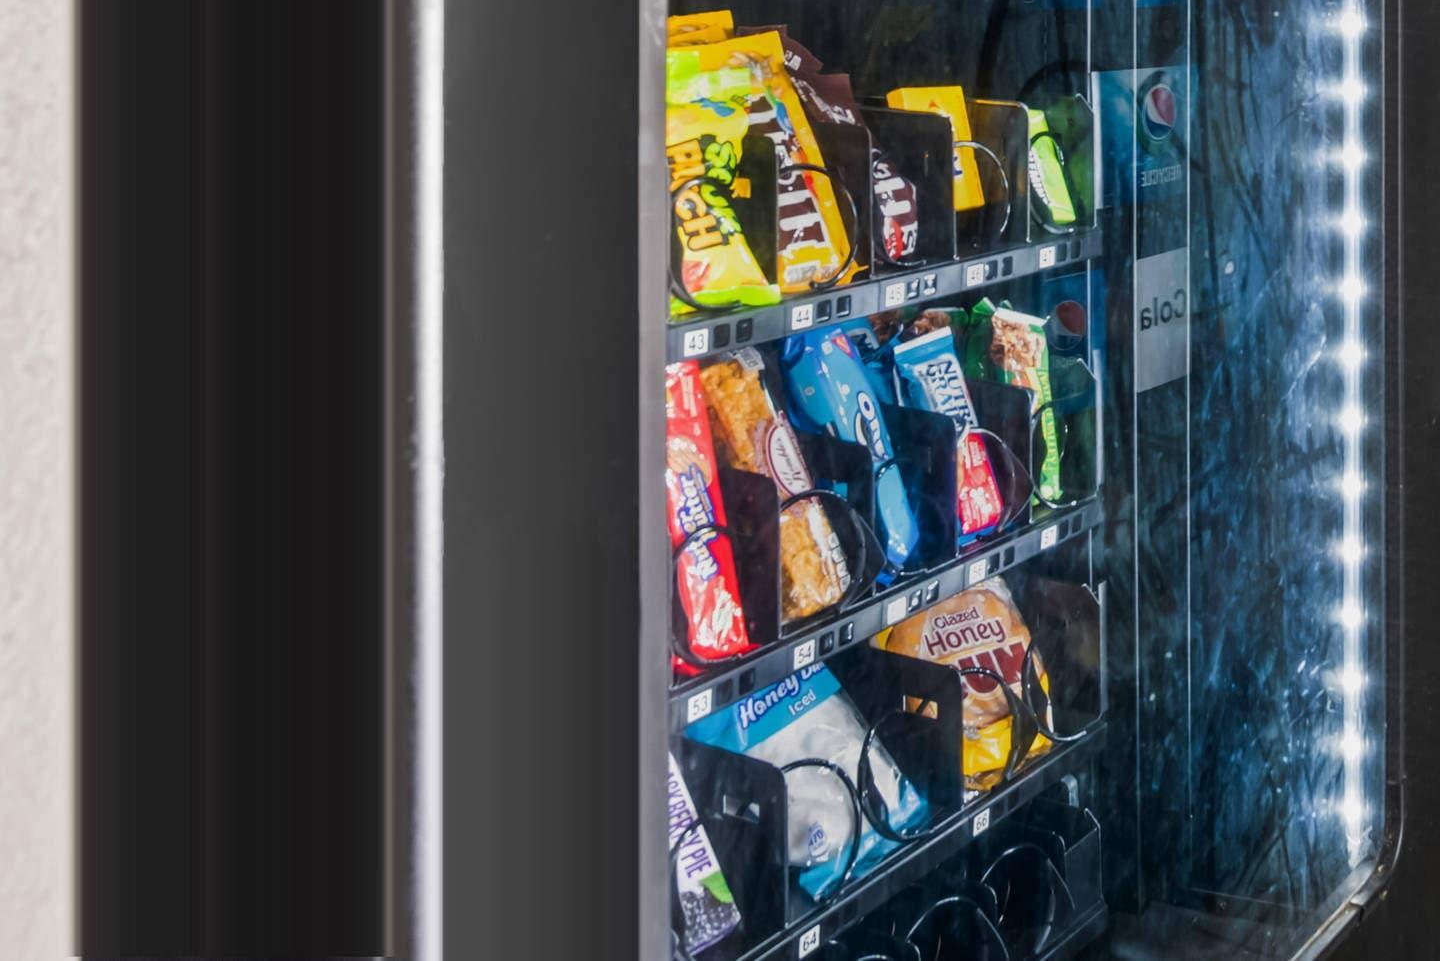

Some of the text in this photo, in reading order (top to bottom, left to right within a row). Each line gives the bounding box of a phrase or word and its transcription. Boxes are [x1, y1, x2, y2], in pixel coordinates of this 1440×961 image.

[934, 606, 980, 629] Glazed
[924, 619, 1006, 656] Honey
[956, 641, 1027, 696] UN
[740, 674, 799, 728] Honey
[787, 687, 817, 716] Iced
[681, 846, 713, 878] PIE
